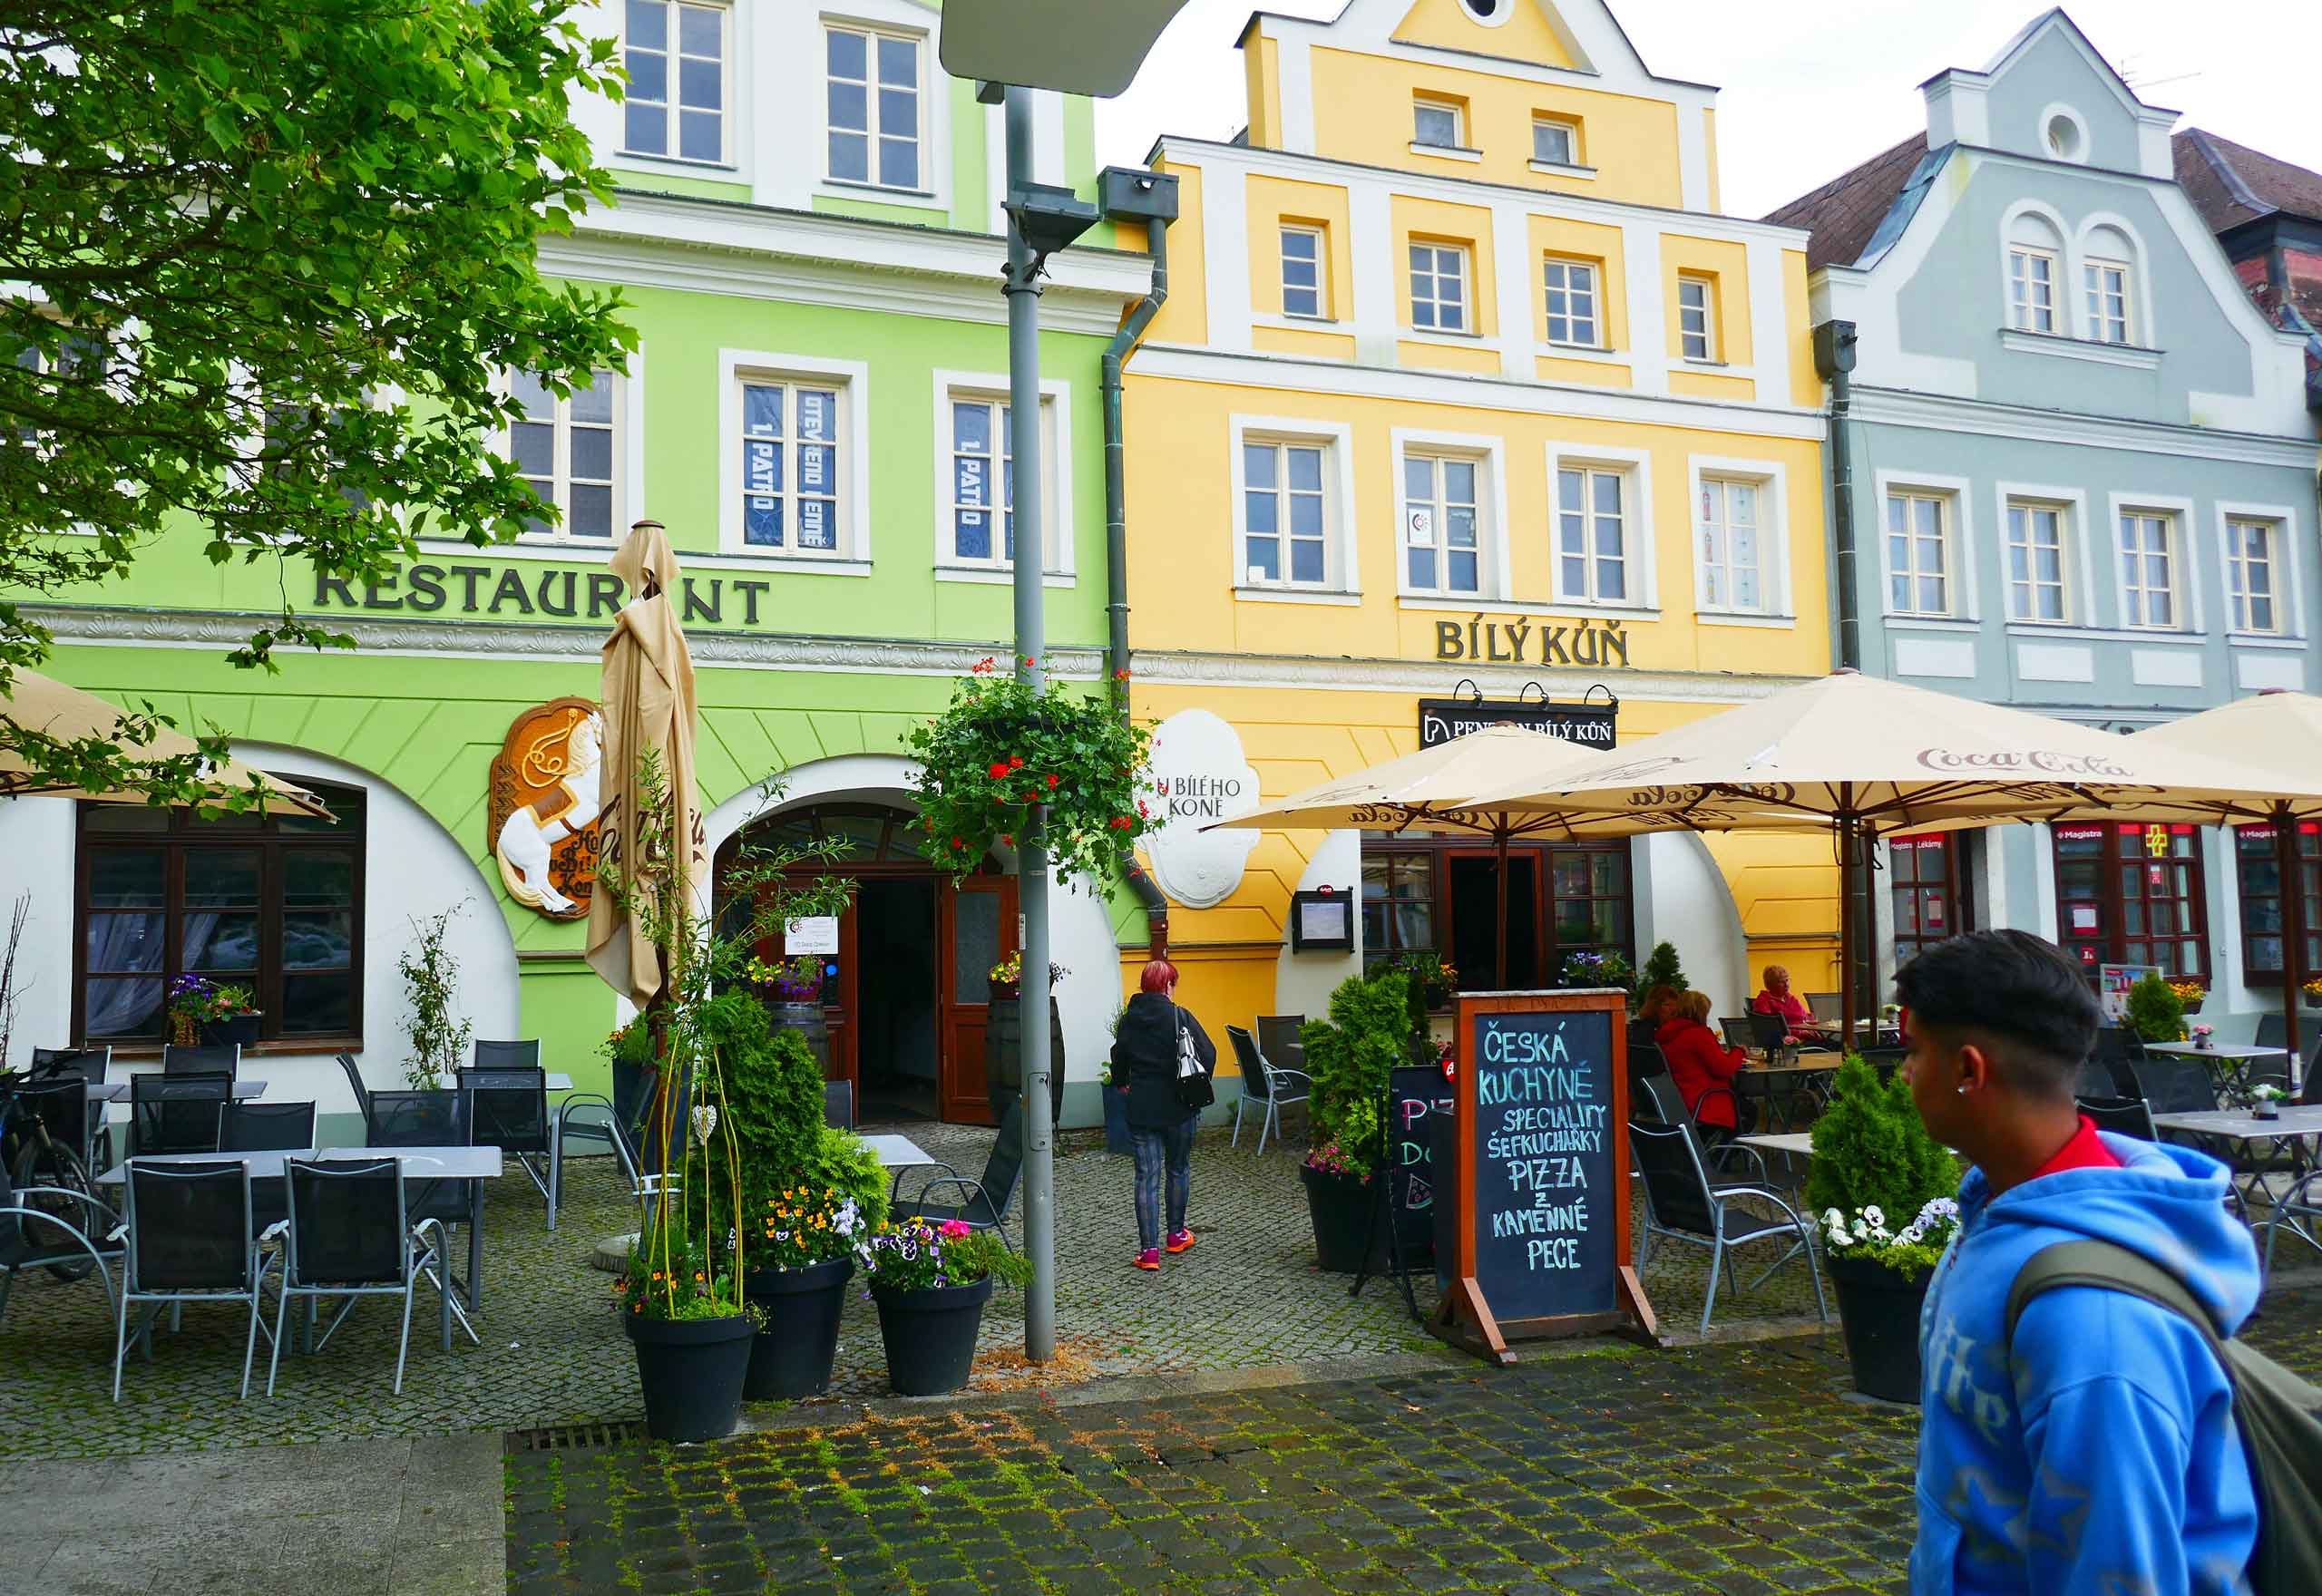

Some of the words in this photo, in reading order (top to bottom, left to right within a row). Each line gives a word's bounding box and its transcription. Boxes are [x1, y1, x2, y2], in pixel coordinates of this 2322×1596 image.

[961, 458, 981, 525] PATO
[313, 561, 770, 624] RESTAURNT
[1436, 612, 1531, 662] BÍLÝ
[1541, 618, 1630, 667] KŮŇ
[1576, 721, 1612, 742] KŮŇ
[1176, 774, 1241, 797] BÍLÉHO
[2064, 830, 2102, 840] Magistra
[1484, 1020, 1568, 1064] ČESKÁ
[1503, 1103, 1606, 1132] SPECIALITY
[1507, 1158, 1587, 1192] PIZZA
[1492, 1196, 1588, 1238] KAMENNÉ
[1527, 1238, 1582, 1270] PECE
